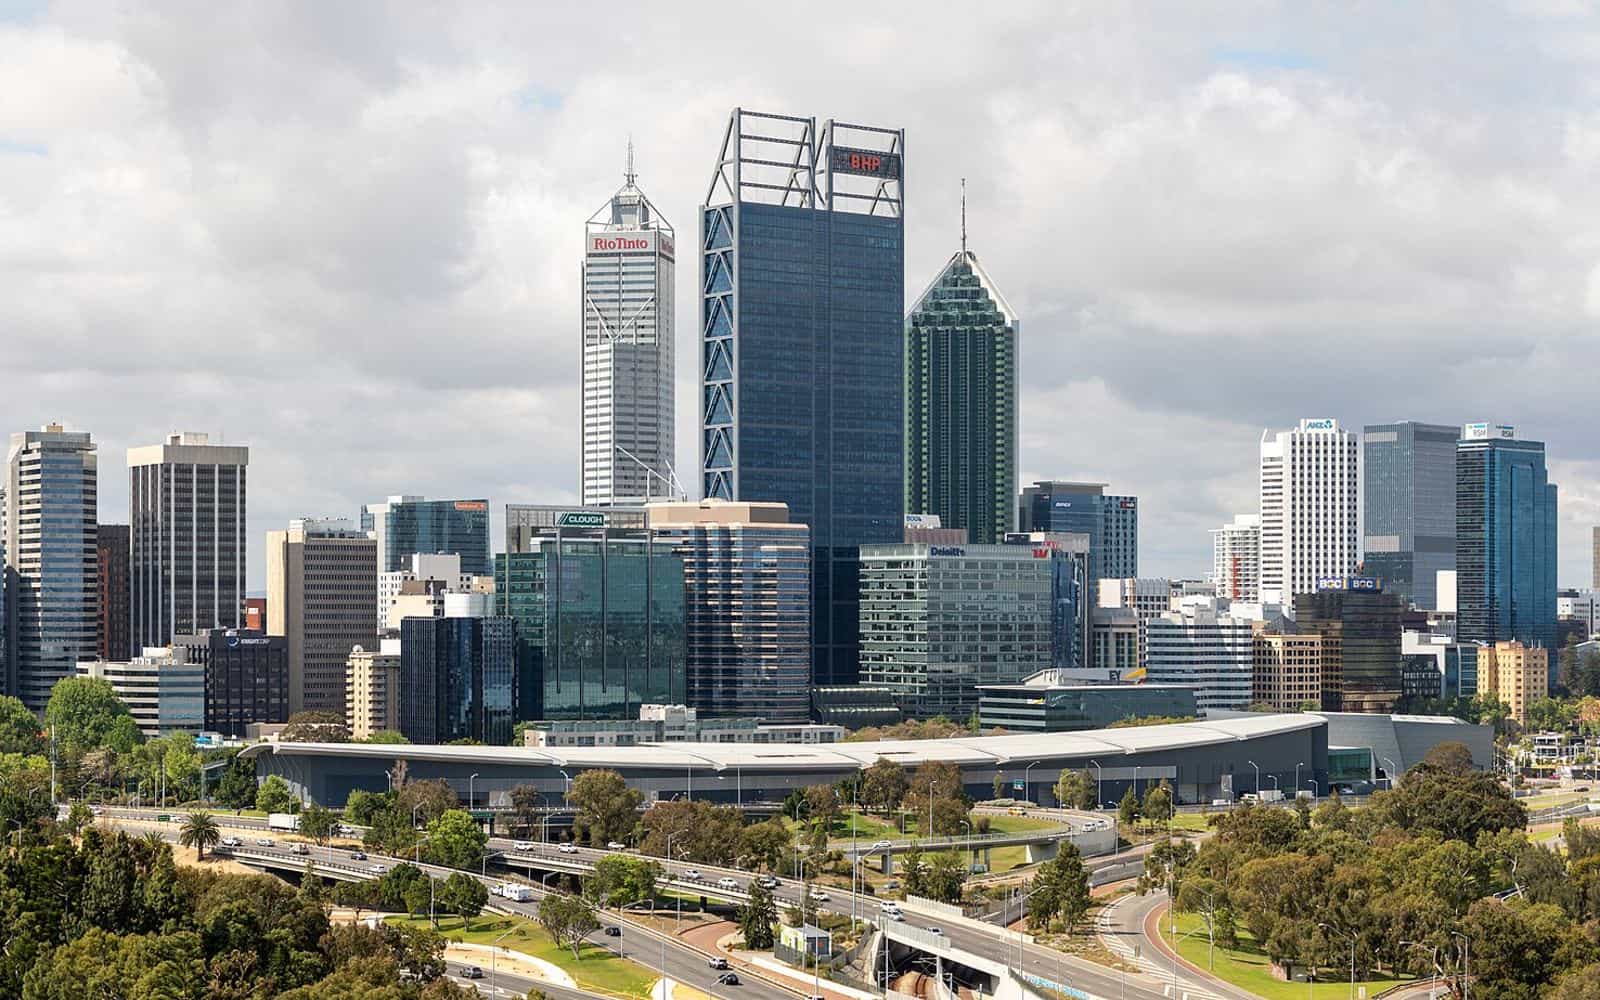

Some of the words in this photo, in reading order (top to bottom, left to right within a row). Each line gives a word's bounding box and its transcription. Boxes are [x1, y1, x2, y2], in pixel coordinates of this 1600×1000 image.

[850, 153, 880, 170] BHP
[568, 515, 602, 523] CLOUGH
[1319, 579, 1342, 588] BGC
[1352, 579, 1374, 587] BGC
[1109, 671, 1121, 681] EY
